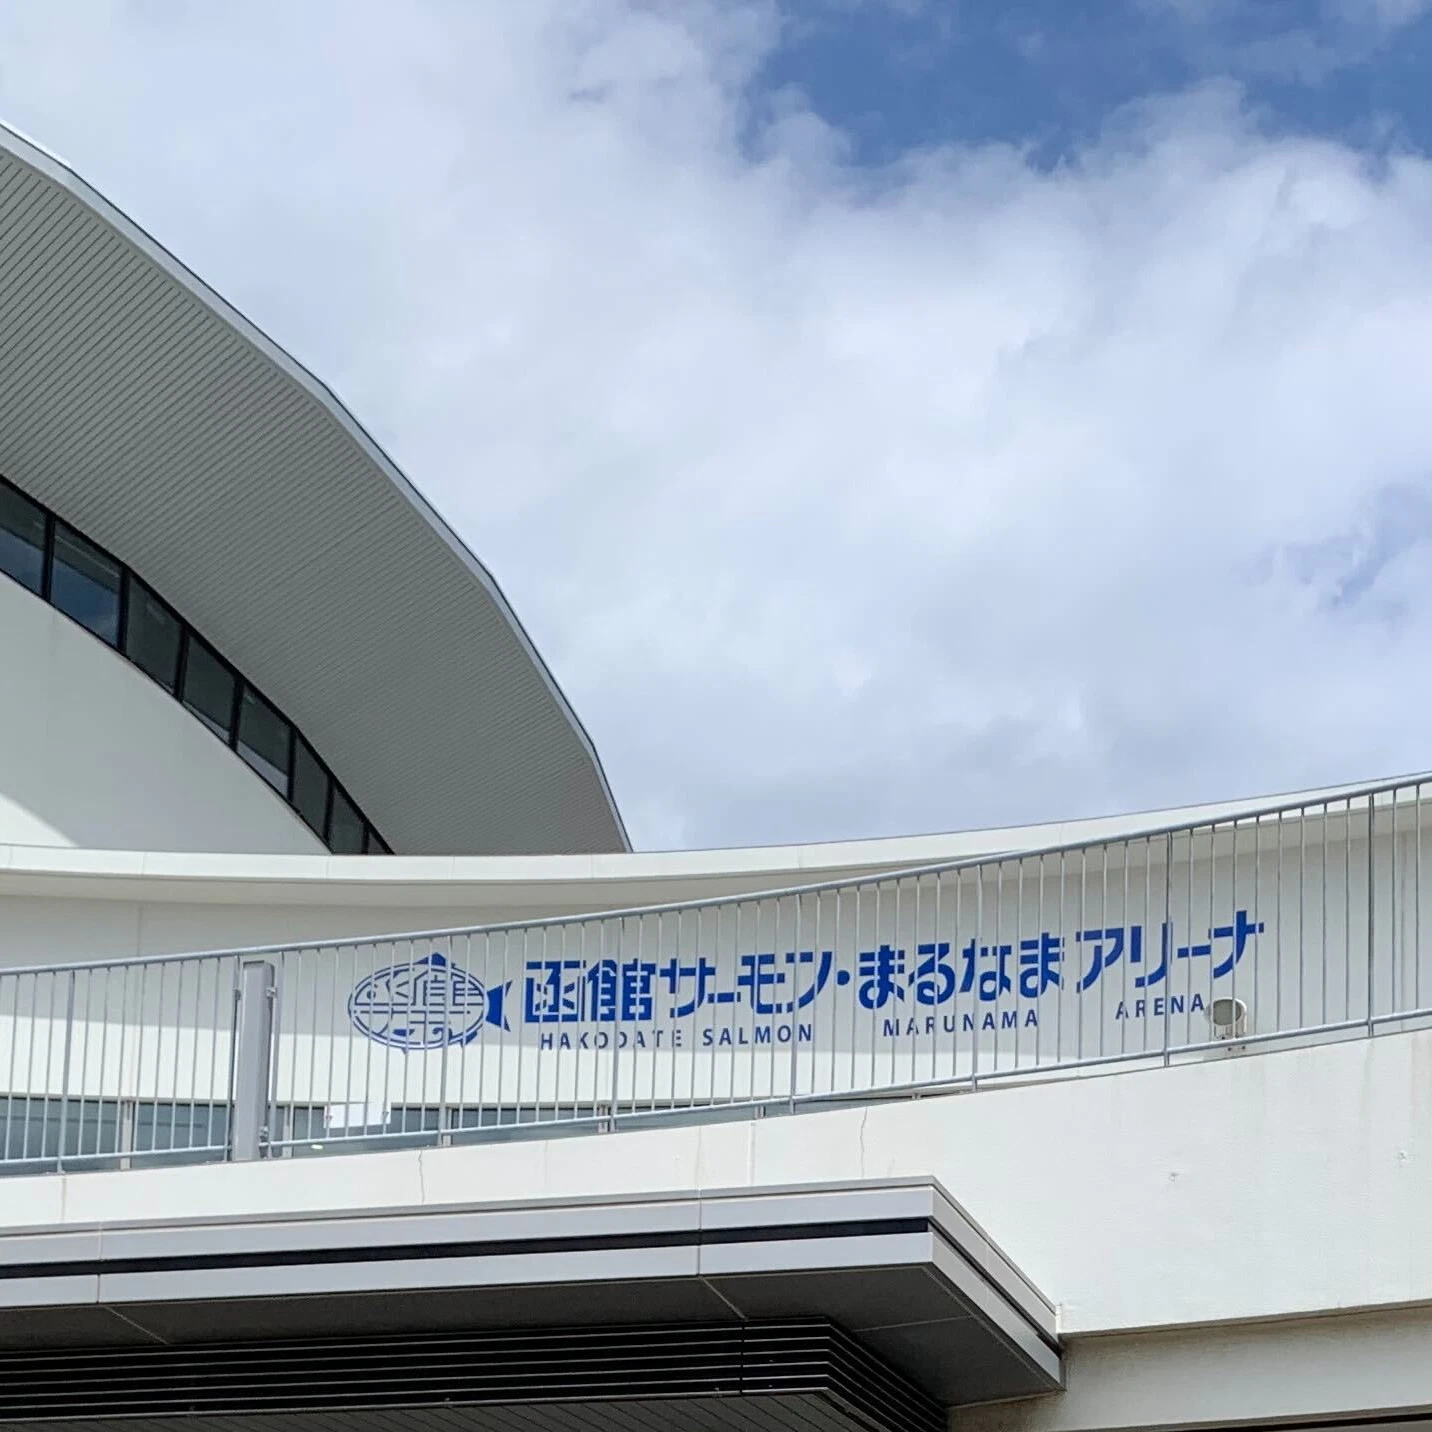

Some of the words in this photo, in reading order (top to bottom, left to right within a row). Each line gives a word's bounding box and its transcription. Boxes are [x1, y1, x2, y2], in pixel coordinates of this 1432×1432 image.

[540, 1029, 682, 1051] HAKODATE
[702, 1023, 813, 1047] SALMON
[883, 1008, 1039, 1037] MARUNAMA
[1115, 993, 1205, 1020] ARENA
